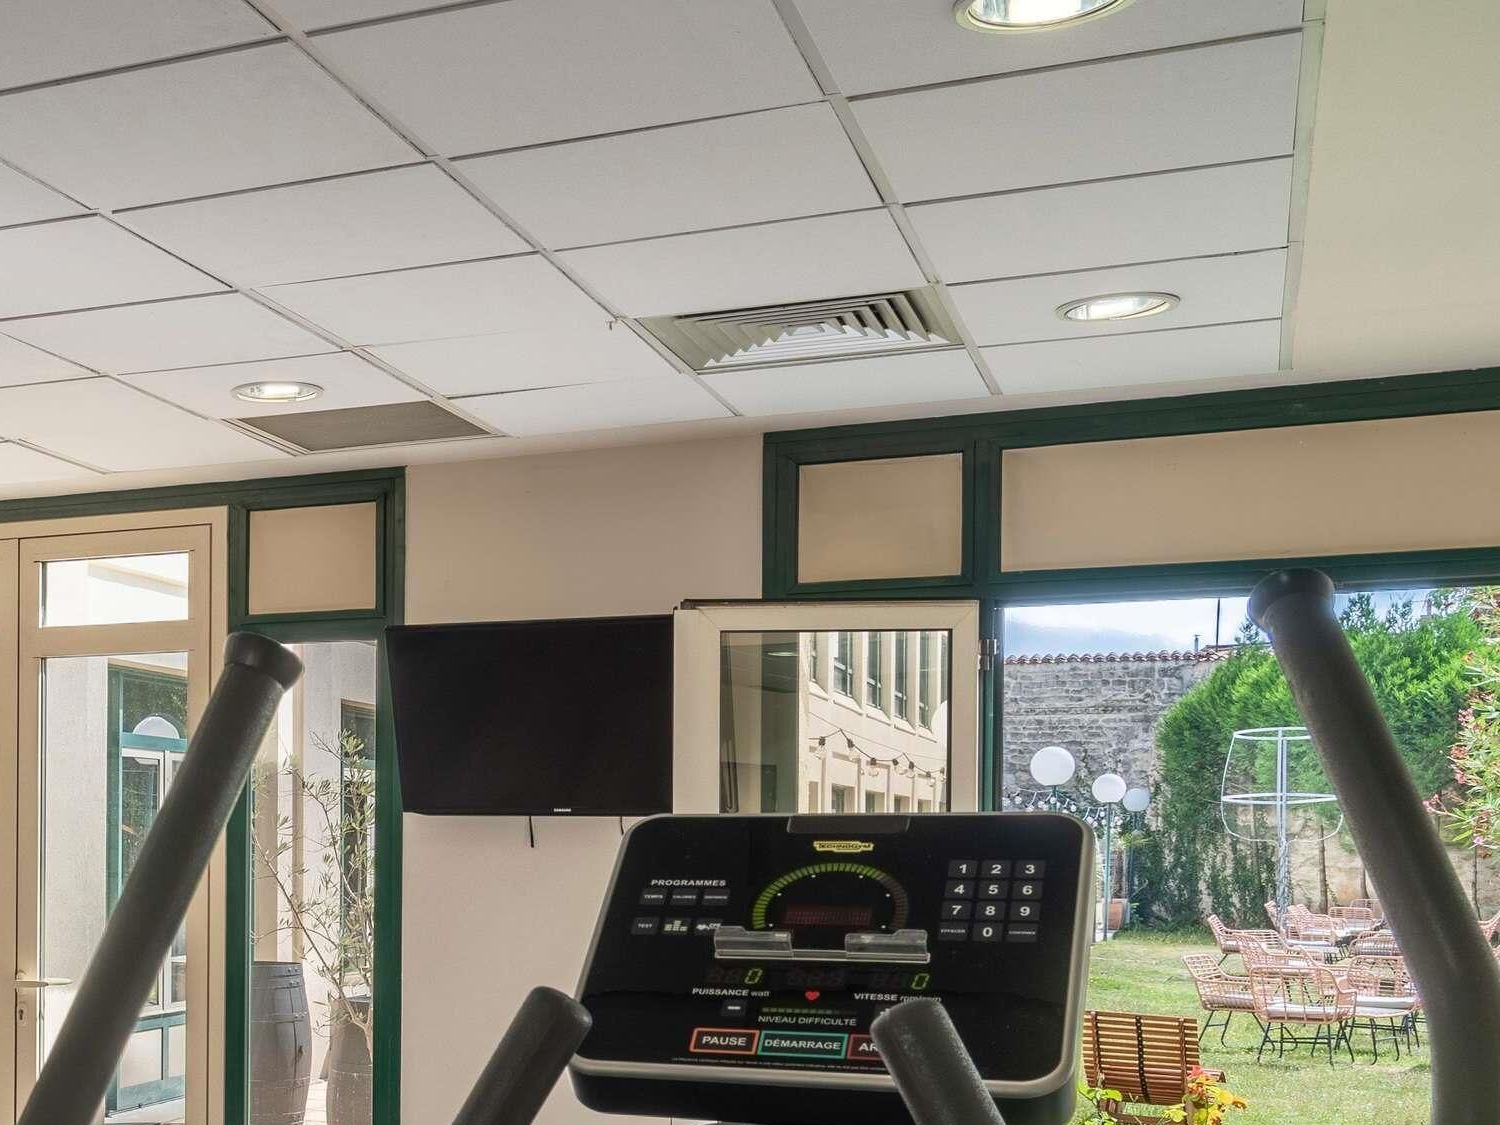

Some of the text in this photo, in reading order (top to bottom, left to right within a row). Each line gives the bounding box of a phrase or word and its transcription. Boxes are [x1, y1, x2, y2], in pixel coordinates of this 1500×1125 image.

[959, 863, 1035, 874] 1 2 3
[651, 879, 727, 887] PROGRAMMES
[954, 884, 1033, 895] 4 5 6
[951, 905, 1031, 917] 7 8 9
[982, 927, 993, 938] 0
[744, 968, 763, 984] 0
[911, 973, 930, 990] 0
[692, 987, 749, 997] PUISSANCE
[854, 992, 898, 1001] VITESSE
[758, 1015, 796, 1024] NIVEAU
[701, 1036, 747, 1046] PAUSE
[764, 1038, 841, 1050] DÉMARRAGE
